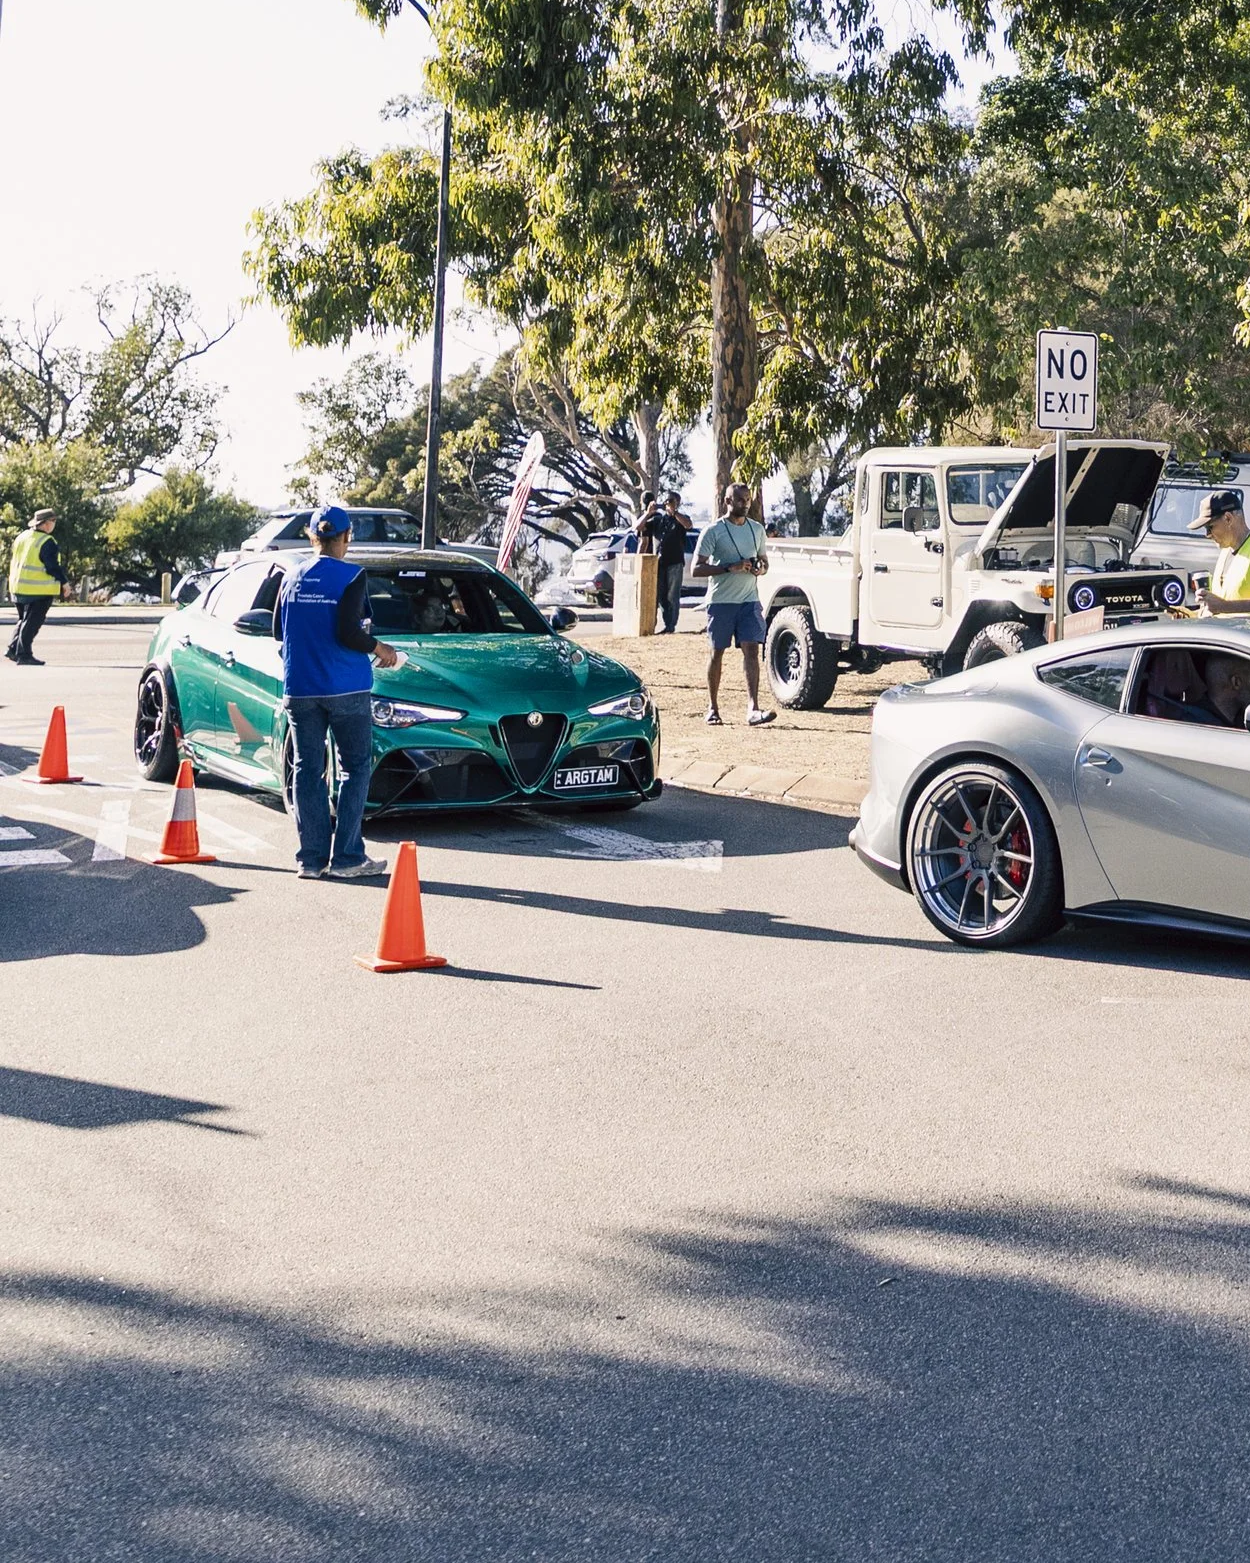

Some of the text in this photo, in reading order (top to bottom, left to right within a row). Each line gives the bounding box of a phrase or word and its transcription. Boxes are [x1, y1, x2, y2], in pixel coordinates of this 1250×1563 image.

[1047, 347, 1088, 381] NO
[1044, 391, 1090, 415] EXIT
[1105, 595, 1144, 603] TOYOTA
[564, 768, 613, 785] ARGTAM
